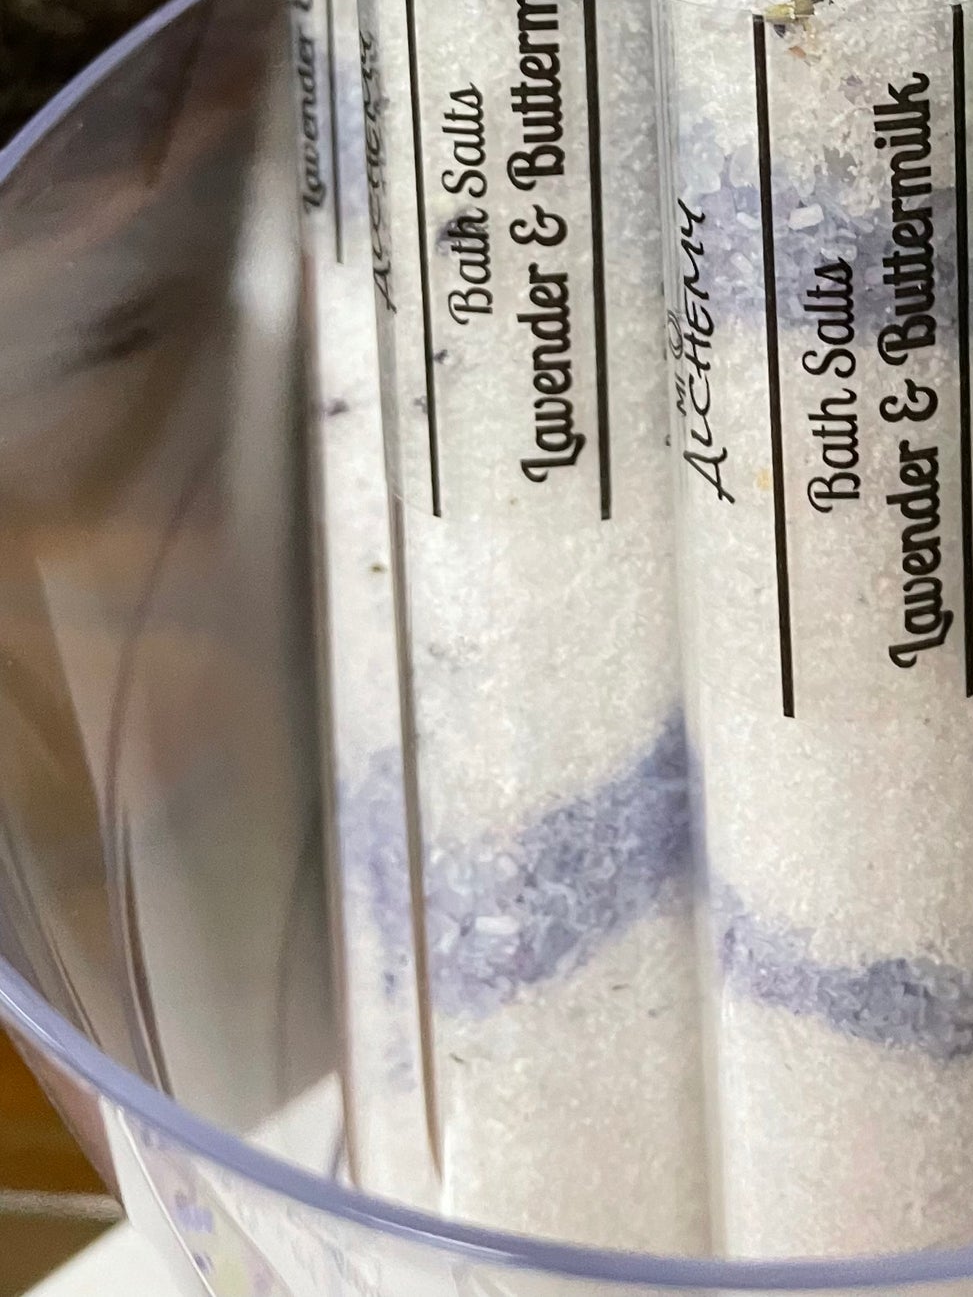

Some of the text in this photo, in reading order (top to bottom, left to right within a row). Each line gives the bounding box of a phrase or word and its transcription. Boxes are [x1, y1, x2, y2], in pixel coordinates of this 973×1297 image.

[299, 33, 328, 213] Lavender
[441, 82, 494, 326] Bath Salts
[509, 204, 568, 247] &
[521, 263, 586, 484] Lavender
[677, 198, 735, 504] ALCHEMY
[802, 256, 860, 513] Bath Salts
[873, 71, 954, 668] Lavender & Buttermilk
